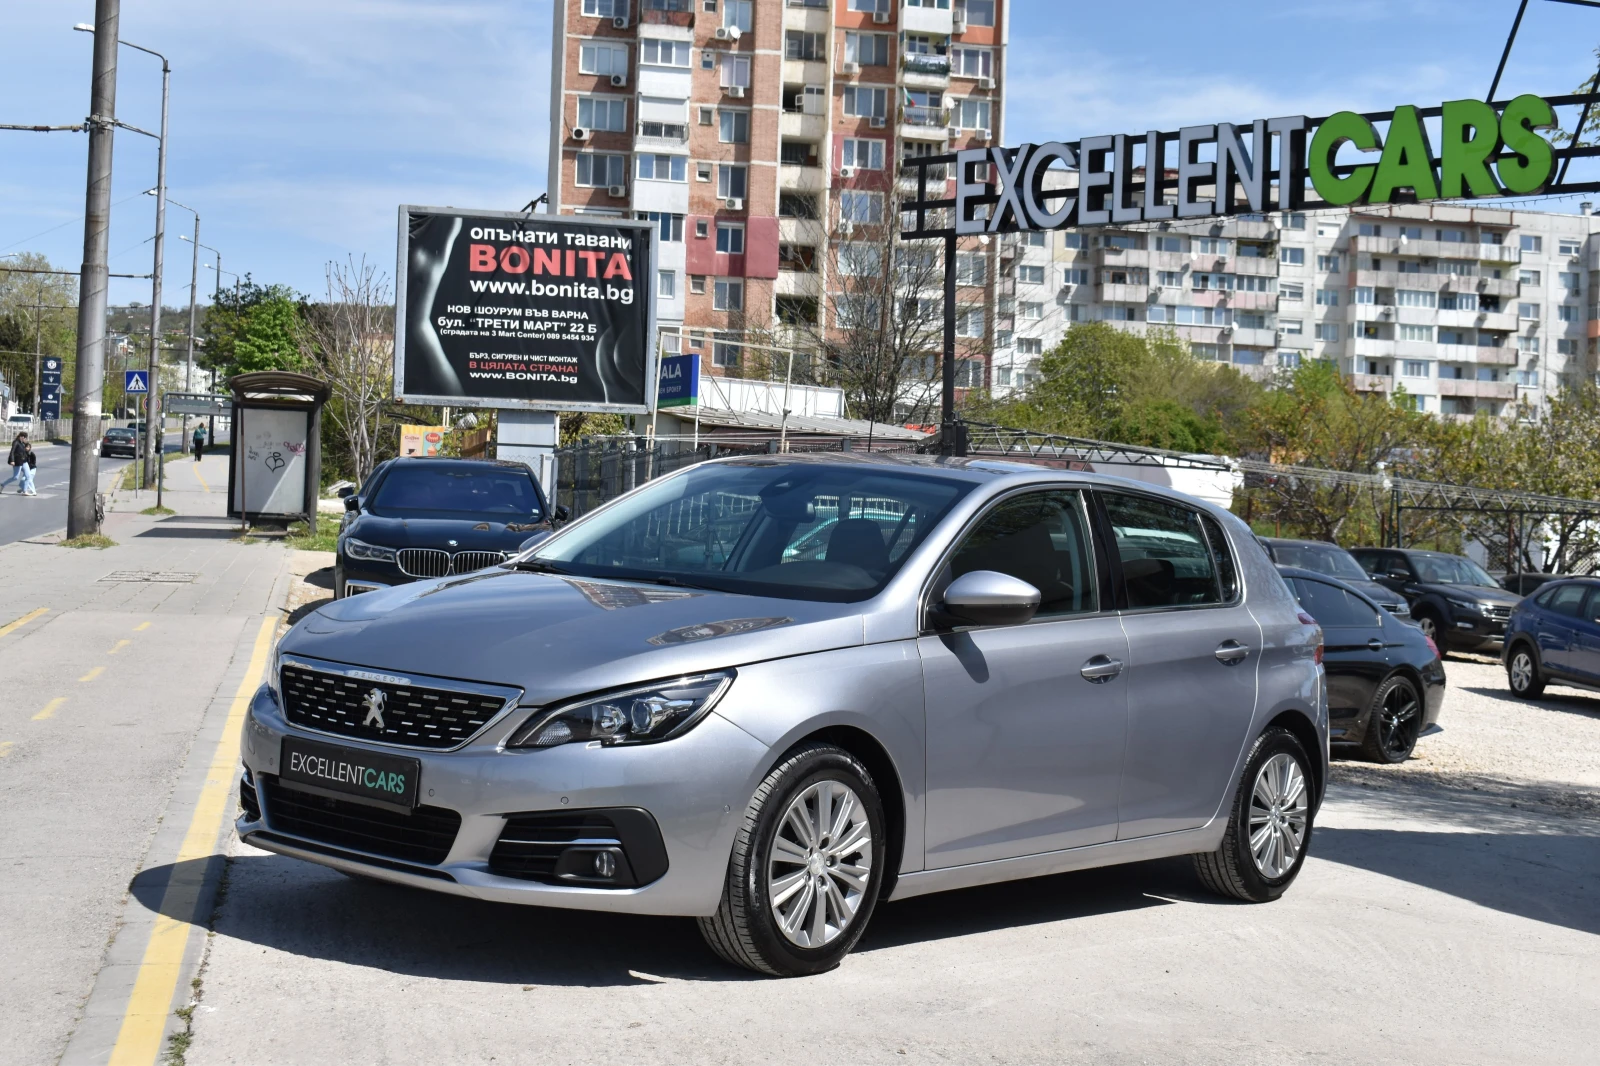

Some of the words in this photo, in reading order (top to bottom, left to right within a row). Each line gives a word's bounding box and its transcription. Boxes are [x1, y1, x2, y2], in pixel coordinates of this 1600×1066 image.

[470, 228, 558, 244] опънати
[564, 233, 632, 250] тавани
[470, 244, 632, 280] BONITA
[470, 280, 634, 305] www.bonita.bg
[447, 305, 471, 314] НОВ
[474, 306, 522, 316] ШОУРУМ
[525, 309, 549, 317] ВЪВ
[552, 310, 588, 320] ВАРНА
[438, 317, 465, 328] бул.
[570, 323, 584, 333] 22
[588, 324, 597, 333] Б
[440, 328, 478, 337] (сградата
[517, 331, 545, 340] Center)
[470, 352, 490, 360] БЪРЗ,
[469, 361, 477, 369] В
[480, 362, 526, 371] ЦЯЛАТА
[530, 364, 578, 373] СТРАНА!
[470, 372, 578, 384] www.BONITA.bg
[354, 671, 403, 683] PEUGEOT
